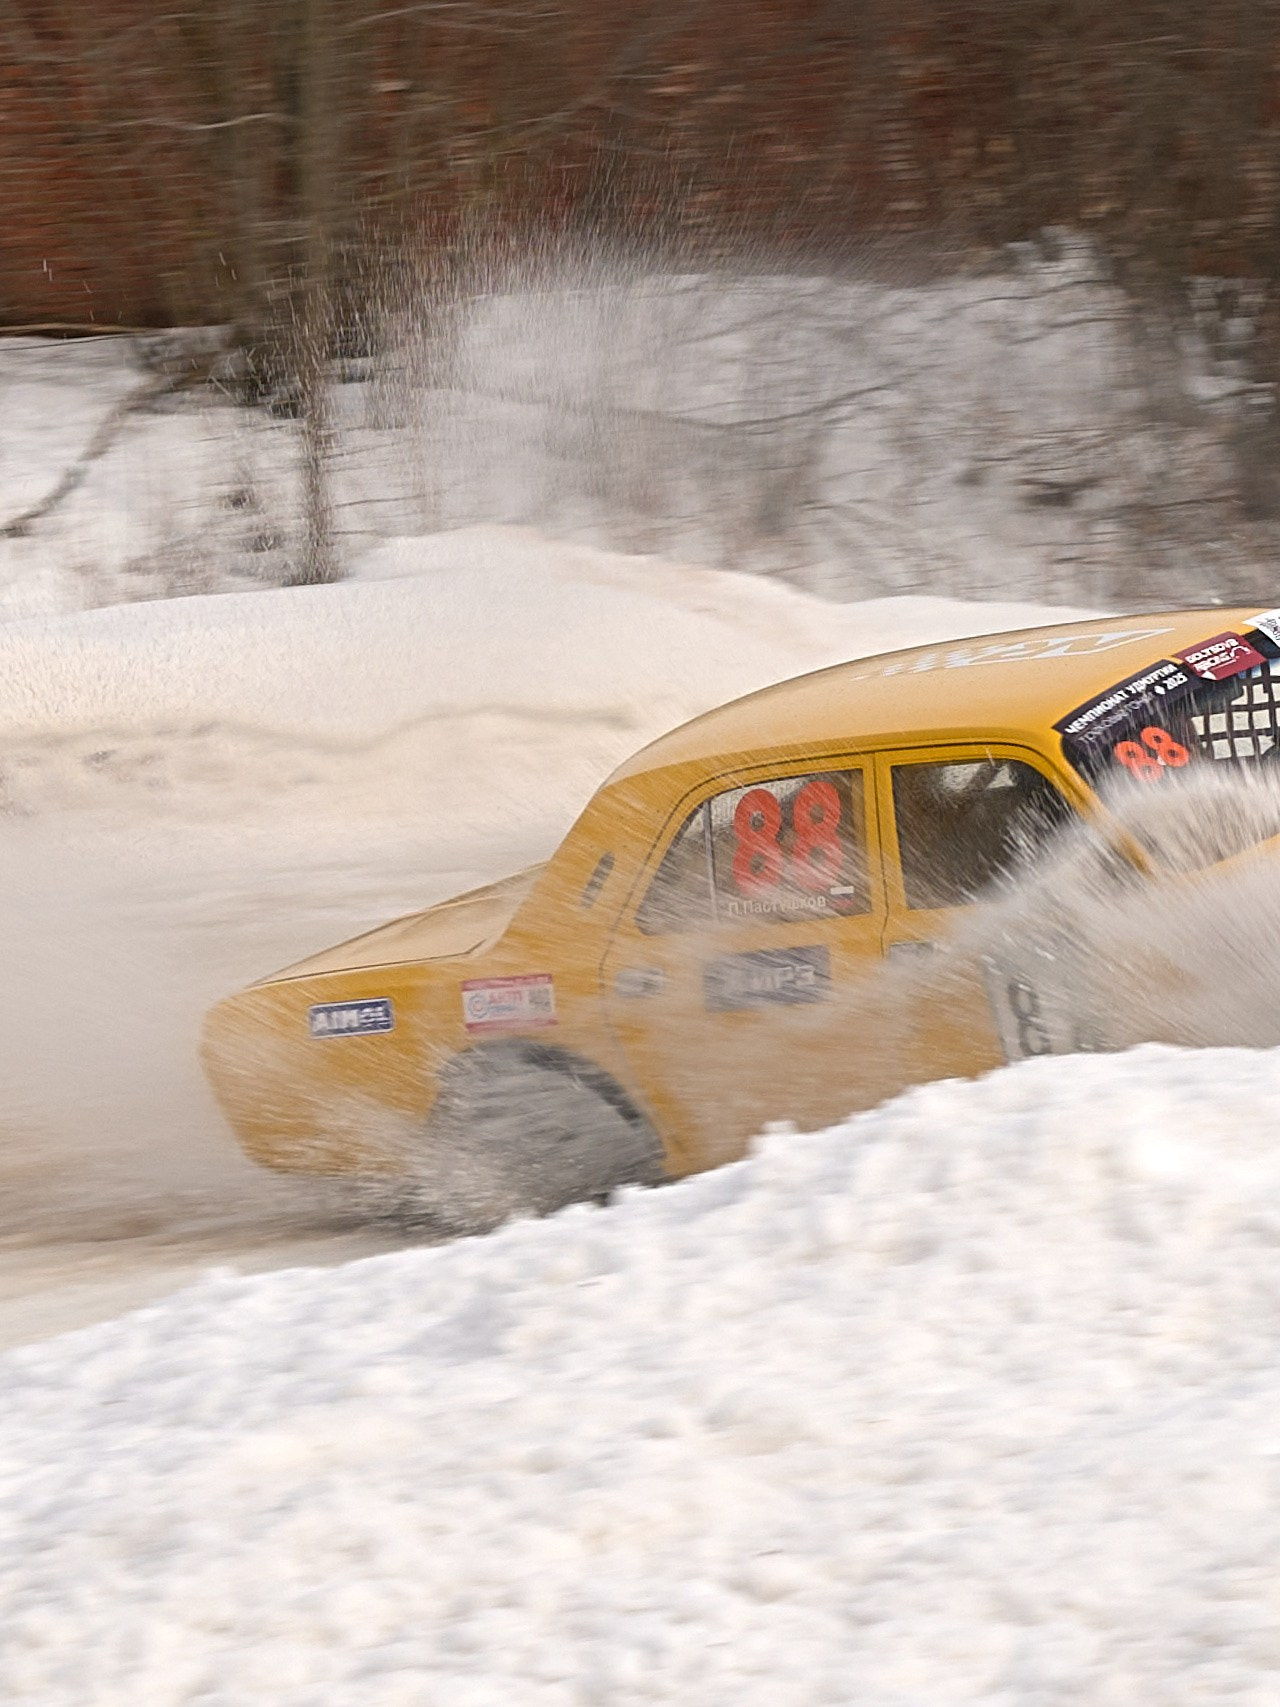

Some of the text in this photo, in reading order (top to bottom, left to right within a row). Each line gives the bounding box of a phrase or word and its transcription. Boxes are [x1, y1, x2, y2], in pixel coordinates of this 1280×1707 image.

[1162, 671, 1188, 690] 2025
[1064, 689, 1130, 734] ЧЕМПИОНАТ
[1114, 726, 1190, 782] 88
[733, 781, 842, 894] 88
